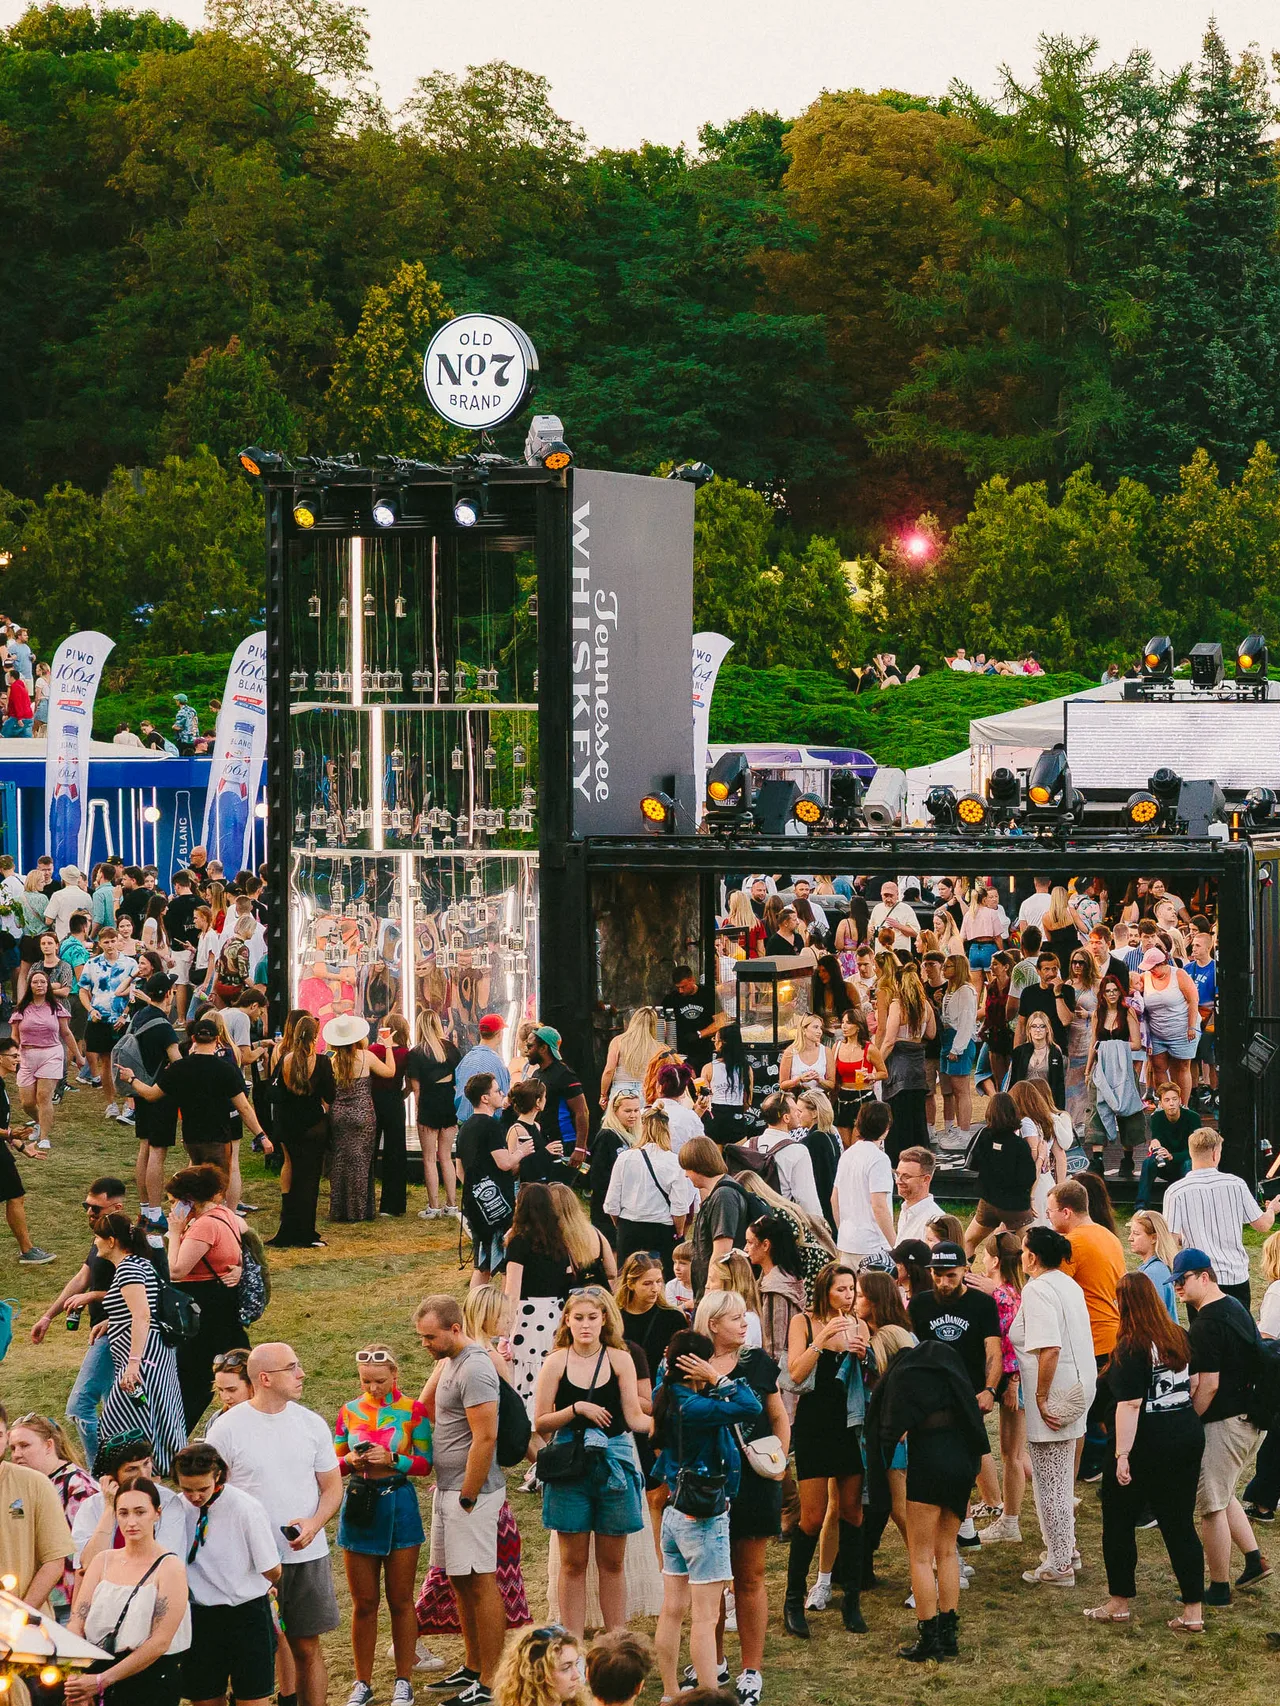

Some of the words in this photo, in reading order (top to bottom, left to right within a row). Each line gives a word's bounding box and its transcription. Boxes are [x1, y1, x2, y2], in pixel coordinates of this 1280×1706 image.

[459, 330, 493, 346] OLD
[449, 394, 501, 411] BRAND
[66, 648, 94, 665] PIWO
[247, 645, 267, 661] PIW
[572, 500, 591, 803] WHISKEY
[56, 663, 95, 687] 1664
[235, 659, 268, 683] 166
[692, 663, 713, 683] 64
[61, 683, 87, 697] BLANC
[238, 679, 265, 695] BLAN
[594, 589, 618, 803] Tennessee
[179, 817, 188, 855] BLANC
[929, 1316, 945, 1330] JACK
[944, 1313, 970, 1331] DANIEL'S
